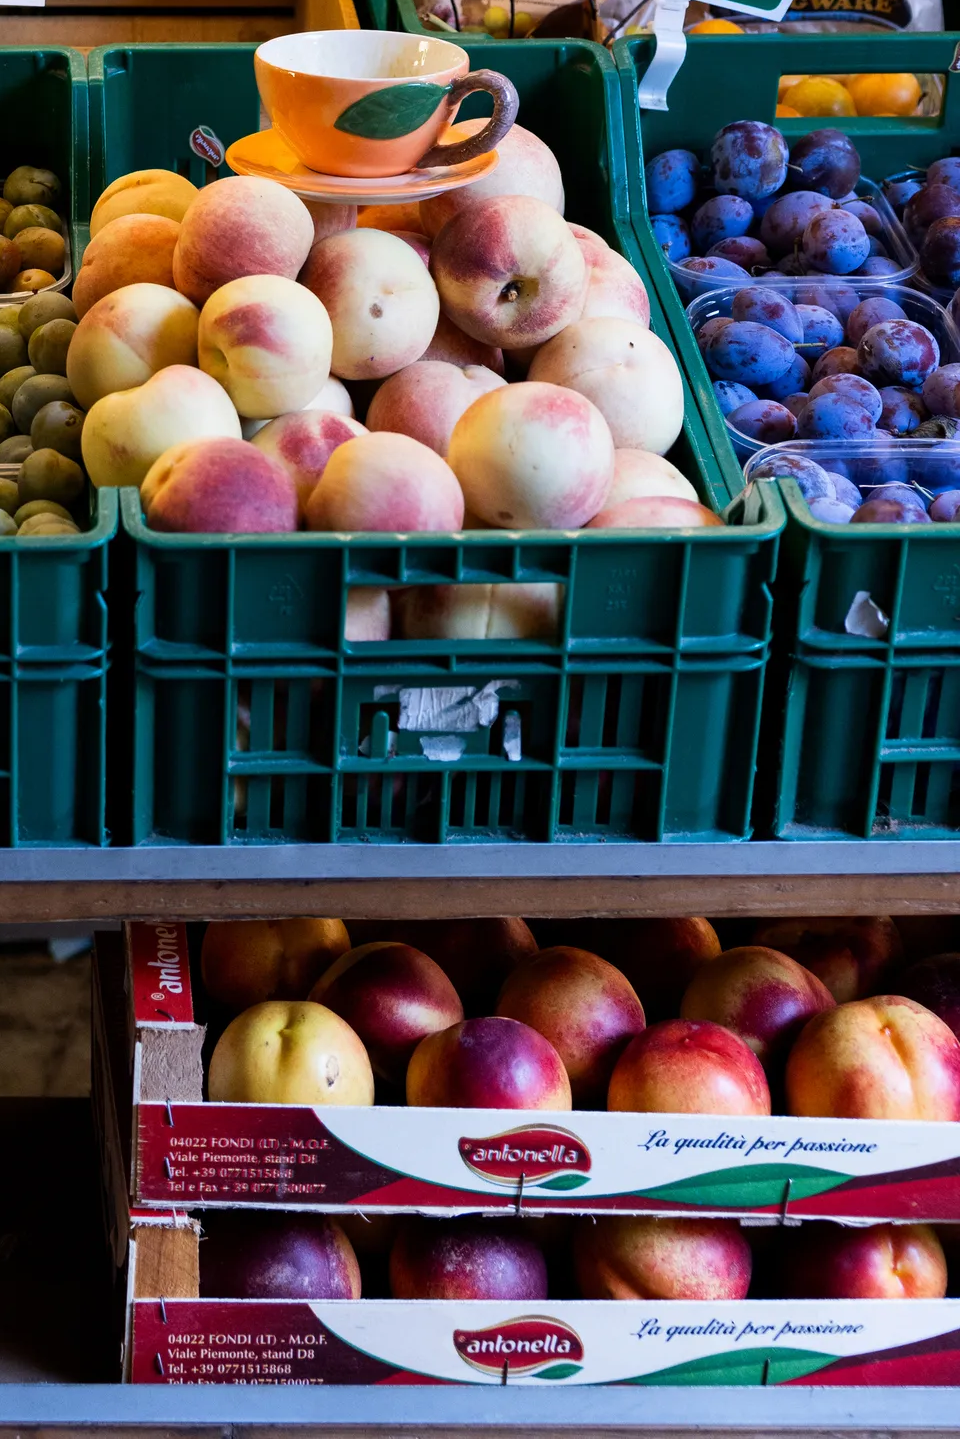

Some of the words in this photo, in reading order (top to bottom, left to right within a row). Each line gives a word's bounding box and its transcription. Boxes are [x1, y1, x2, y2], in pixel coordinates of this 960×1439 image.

[169, 1137, 207, 1148] 04022
[211, 1137, 255, 1149] FONDI
[259, 1138, 280, 1150] (LT)
[638, 1129, 668, 1150] La
[672, 1132, 746, 1152] qualità
[744, 1137, 788, 1156] per
[789, 1138, 878, 1155] passione
[169, 1152, 199, 1162] Viale
[202, 1152, 261, 1164] Piemonte,
[265, 1153, 296, 1163] stand
[473, 1144, 578, 1164] antonella
[170, 1166, 189, 1177] Tel.
[192, 1168, 216, 1177] +39
[169, 1182, 185, 1192] Tel
[188, 1184, 196, 1192] e
[199, 1182, 218, 1192] Fax
[632, 1317, 663, 1338] La
[665, 1319, 738, 1340] qualità
[736, 1322, 777, 1340] per
[774, 1320, 865, 1339] passione
[168, 1334, 205, 1345] 04022
[209, 1334, 252, 1345] FONDI
[256, 1334, 277, 1346] (LT)
[289, 1334, 327, 1345] M.O.F.
[466, 1337, 570, 1356] antonella
[168, 1348, 197, 1359] Viale
[200, 1348, 258, 1361] Piemonte,
[262, 1349, 293, 1359] stand
[297, 1349, 315, 1359] D8
[168, 1363, 187, 1374] Tel.
[191, 1364, 214, 1374] +39
[217, 1364, 292, 1374] 0771515868
